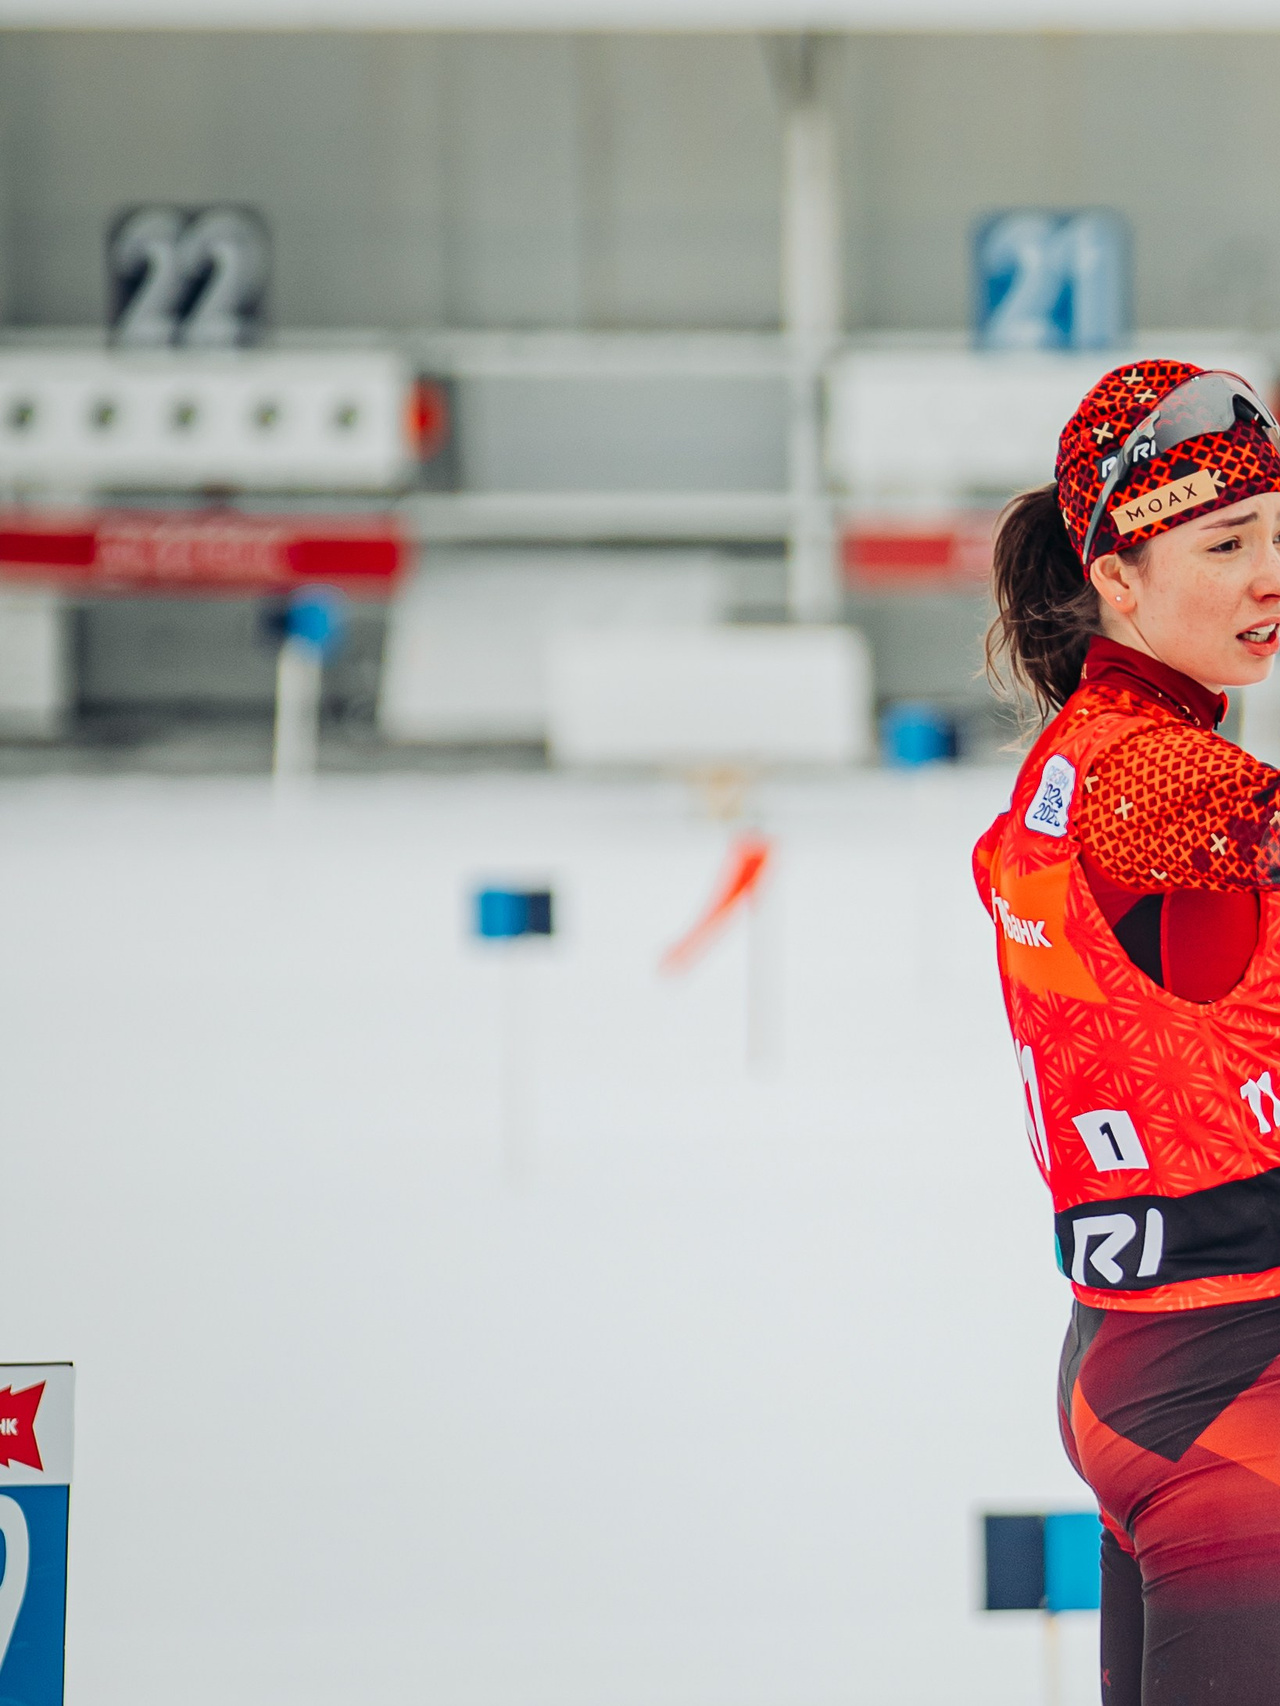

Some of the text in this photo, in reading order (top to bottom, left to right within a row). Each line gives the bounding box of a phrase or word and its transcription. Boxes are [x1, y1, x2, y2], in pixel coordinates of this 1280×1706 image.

[112, 210, 264, 346] 22
[978, 213, 1118, 347] 21
[1101, 439, 1157, 479] PRI
[1125, 482, 1198, 522] MOAX
[1099, 1121, 1124, 1161] 1
[1056, 1207, 1163, 1286] RI
